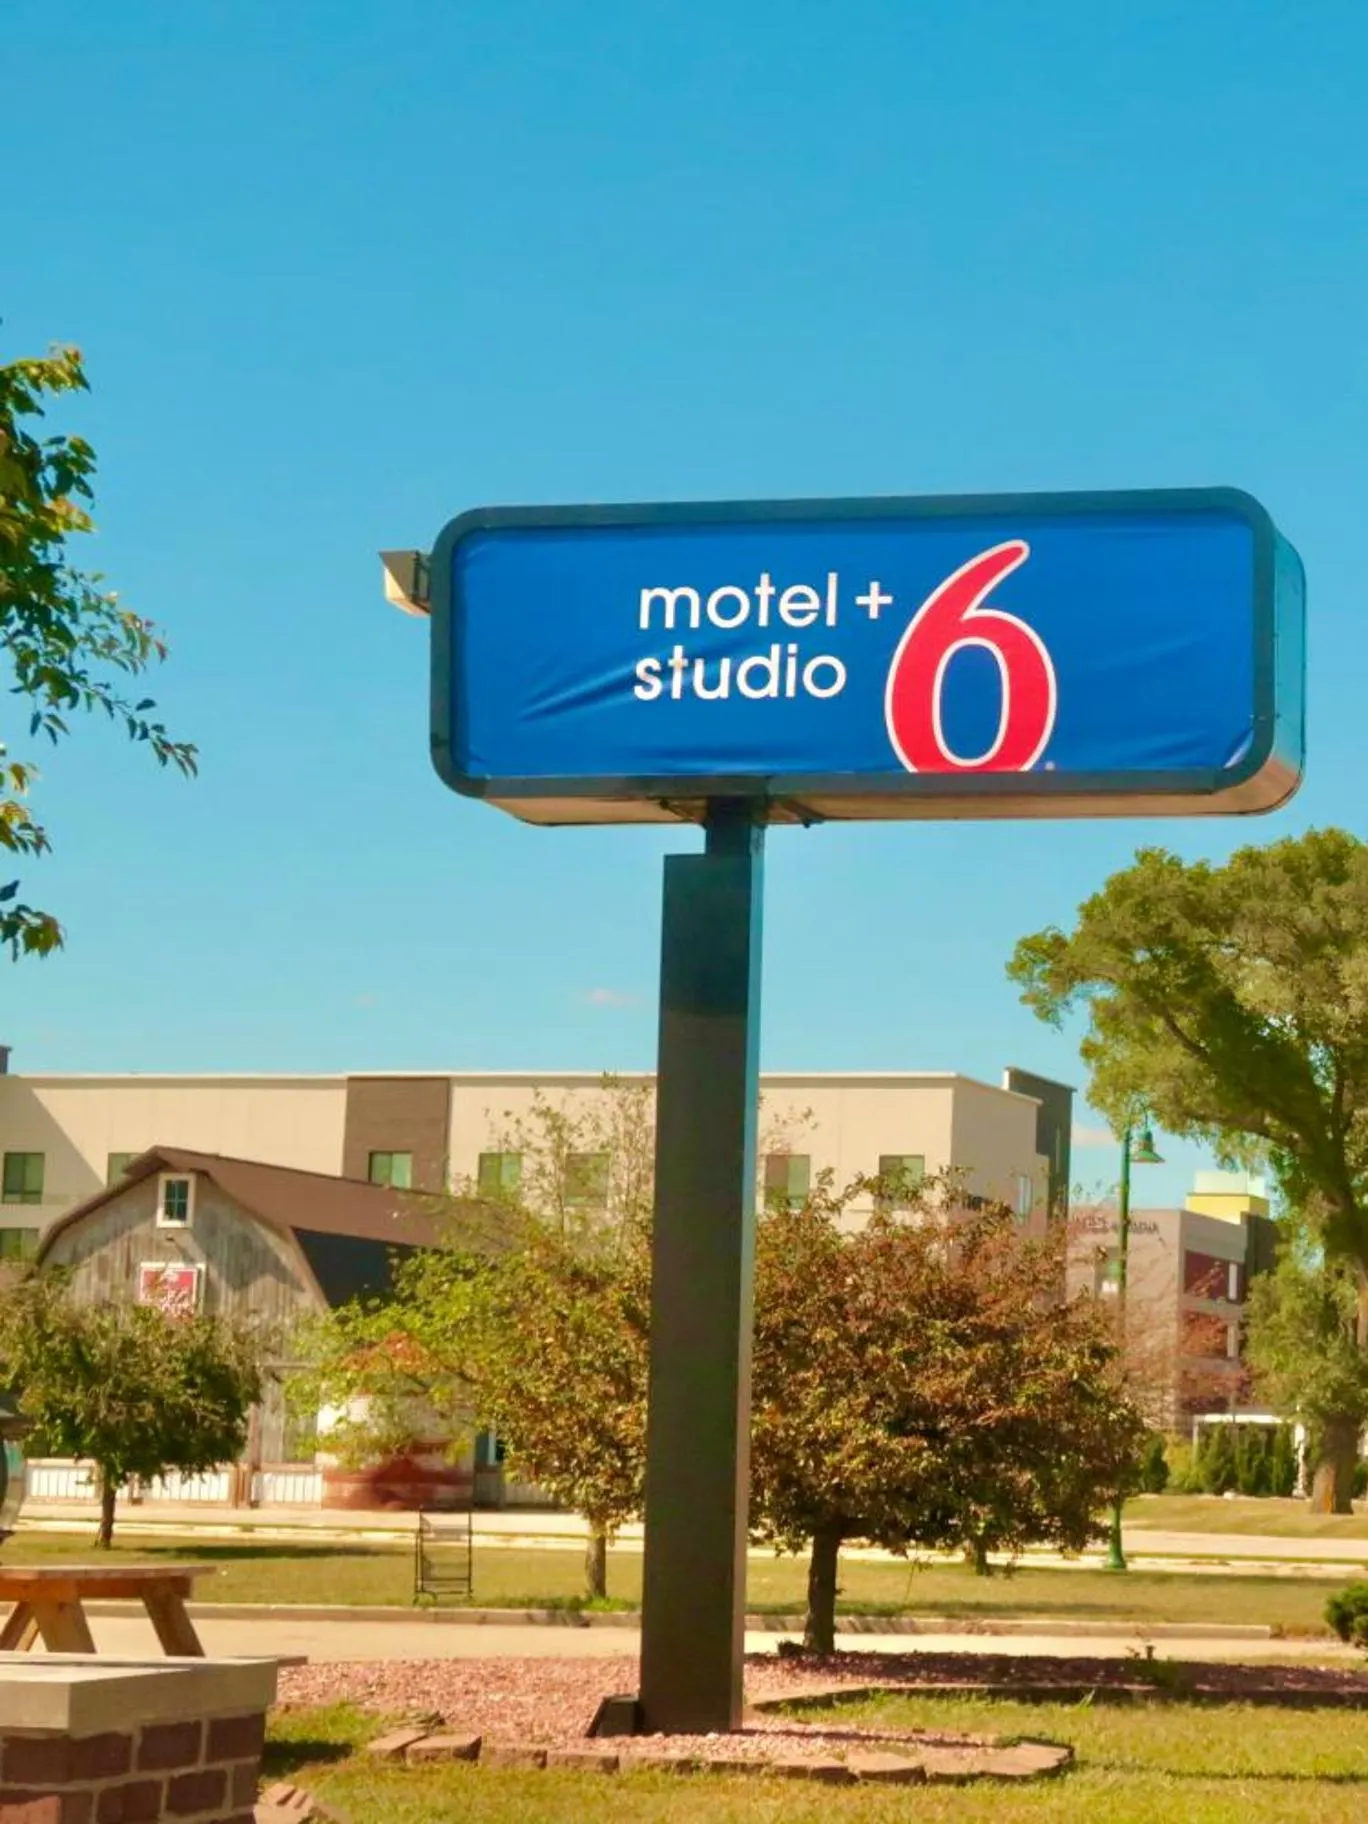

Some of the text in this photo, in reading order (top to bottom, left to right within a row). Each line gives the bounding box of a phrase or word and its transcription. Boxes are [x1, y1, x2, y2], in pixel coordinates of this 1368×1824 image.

[639, 571, 893, 630] motel +
[633, 642, 848, 701] studio
[884, 539, 1058, 772] 6
